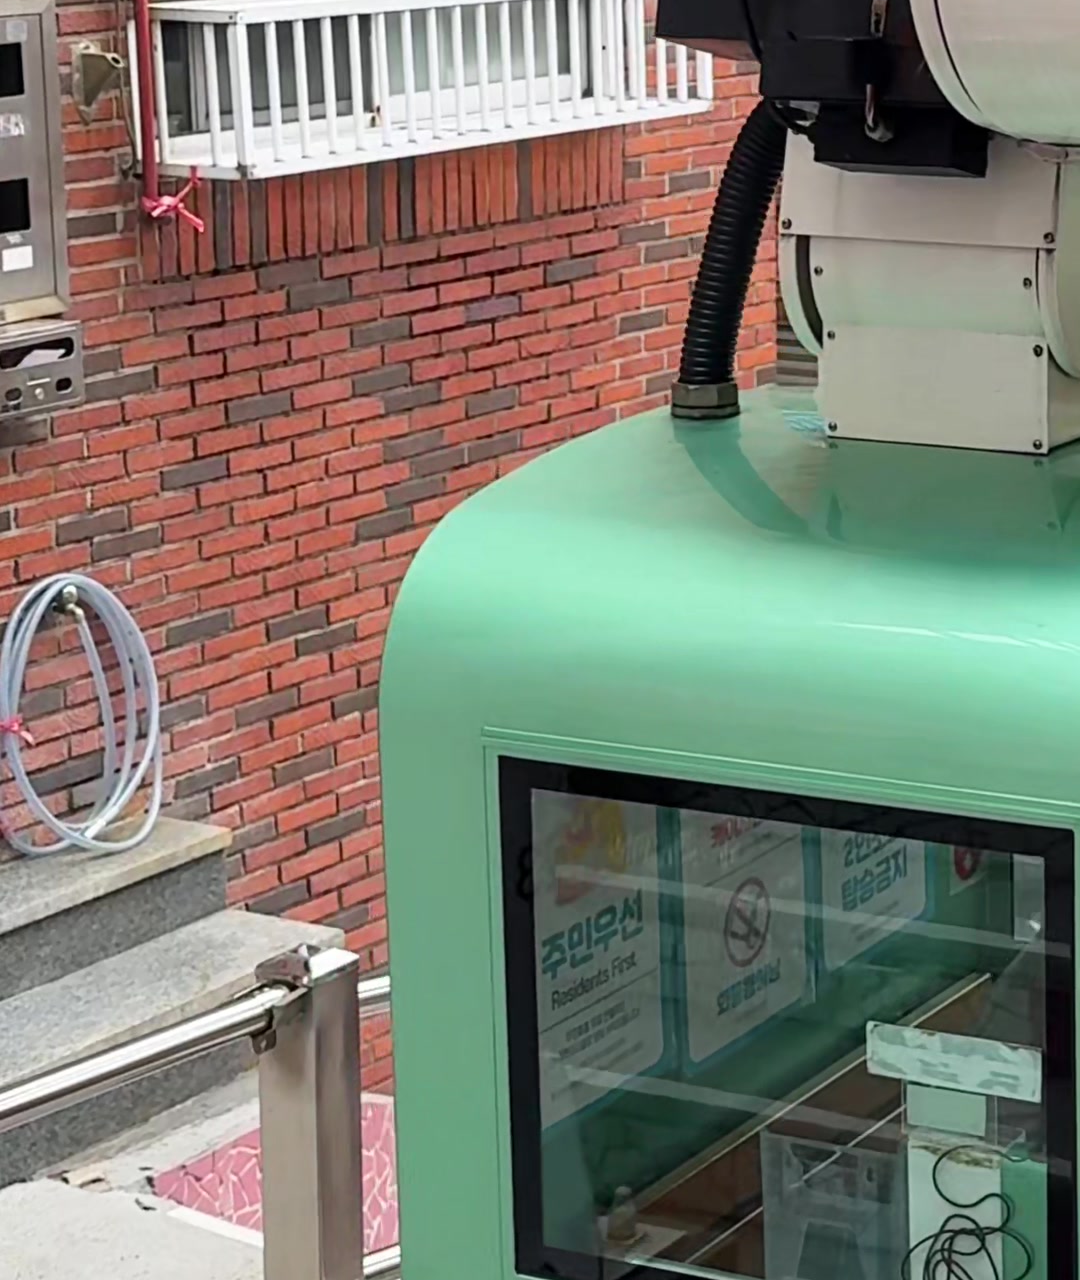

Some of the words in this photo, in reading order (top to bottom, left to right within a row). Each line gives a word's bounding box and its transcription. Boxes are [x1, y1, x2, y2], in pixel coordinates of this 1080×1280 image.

[541, 888, 643, 980] 주민우선
[551, 968, 610, 1011] Residents
[611, 951, 637, 977] First
